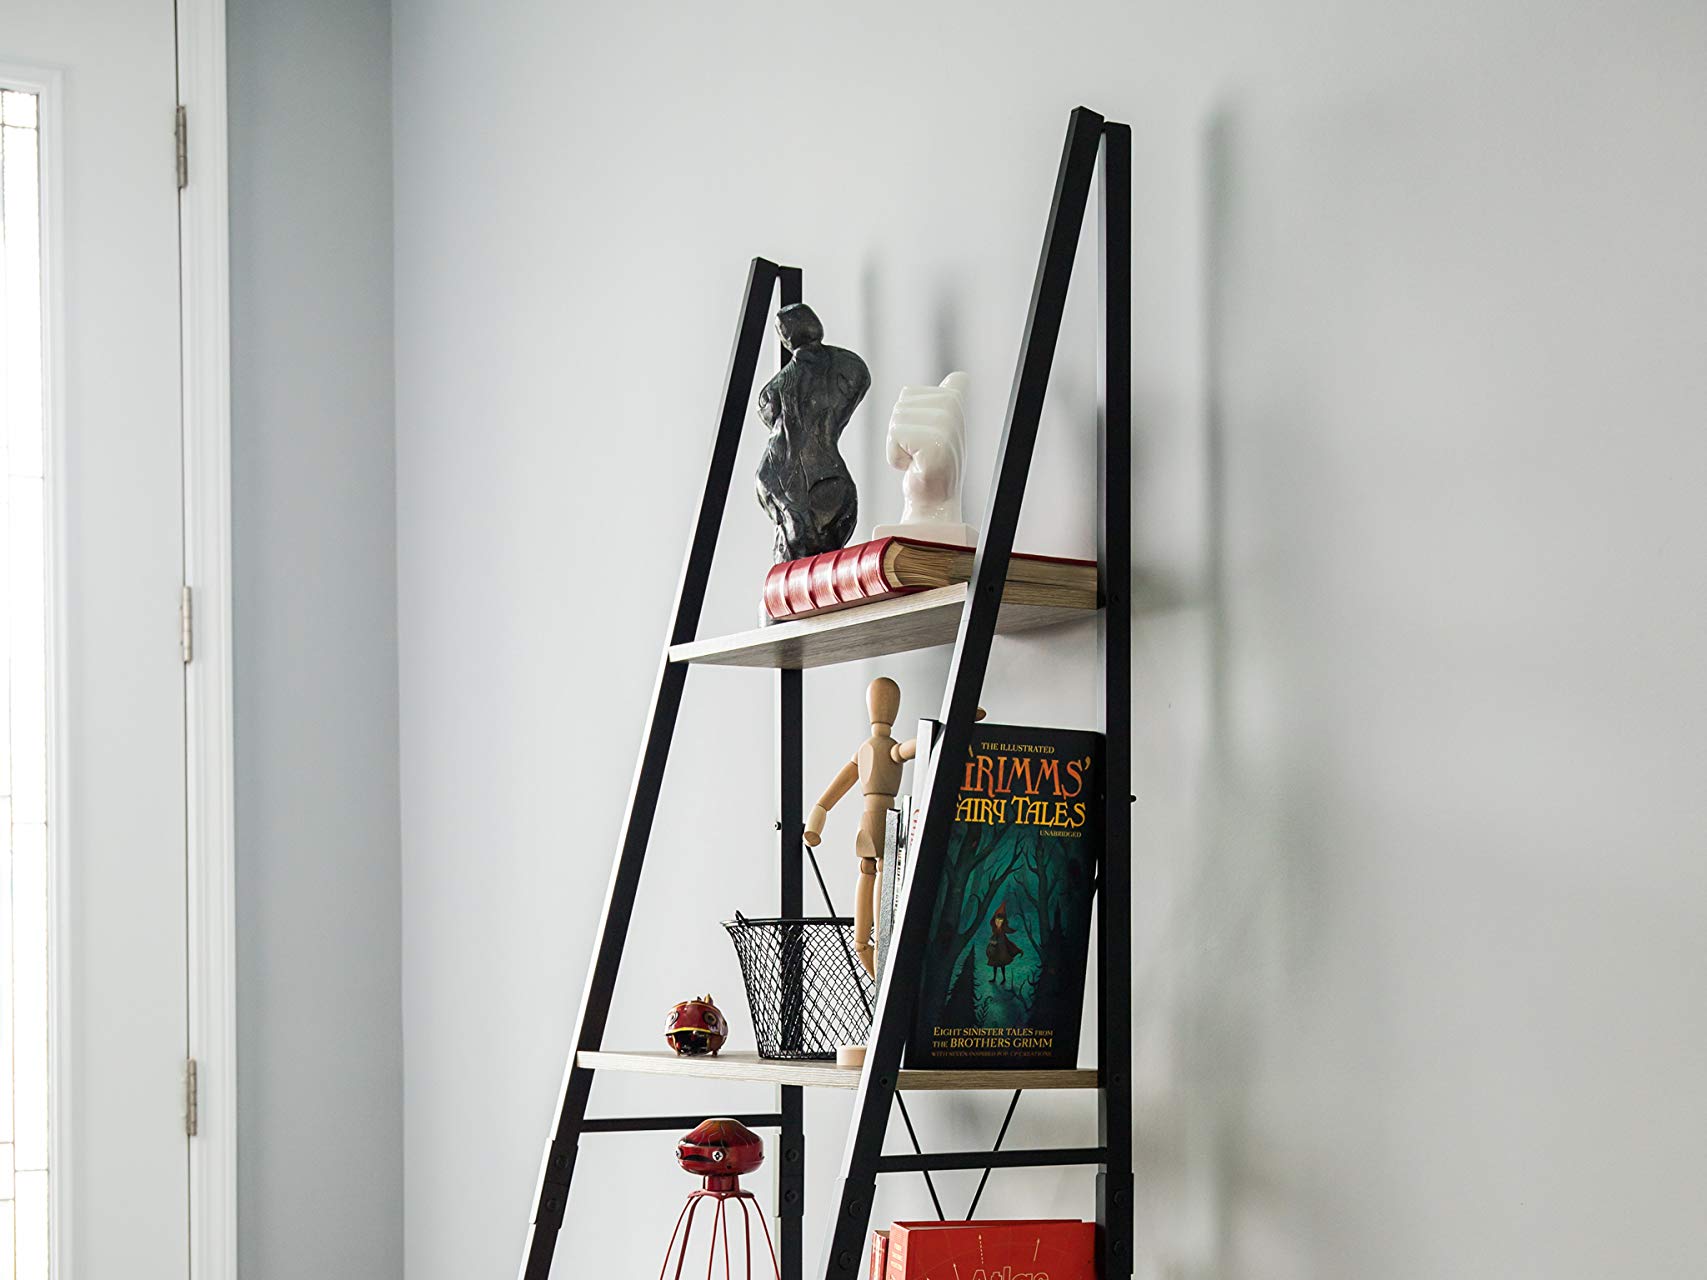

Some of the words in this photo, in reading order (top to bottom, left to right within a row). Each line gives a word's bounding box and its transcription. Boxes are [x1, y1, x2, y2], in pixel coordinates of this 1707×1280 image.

[981, 742, 999, 751] THE
[1000, 743, 1055, 754] ILLUSTRATED
[960, 744, 1092, 800] RIMMS'
[955, 793, 1007, 825] AIRY
[1011, 795, 1087, 829] TALES
[1039, 829, 1082, 838] UNABRIDGED
[962, 1027, 1004, 1036] SINISTER
[1006, 1028, 1034, 1037] TALES
[932, 1040, 948, 1048] THE
[950, 1037, 1011, 1048] BROTHERS
[1012, 1037, 1053, 1048] GRIMM
